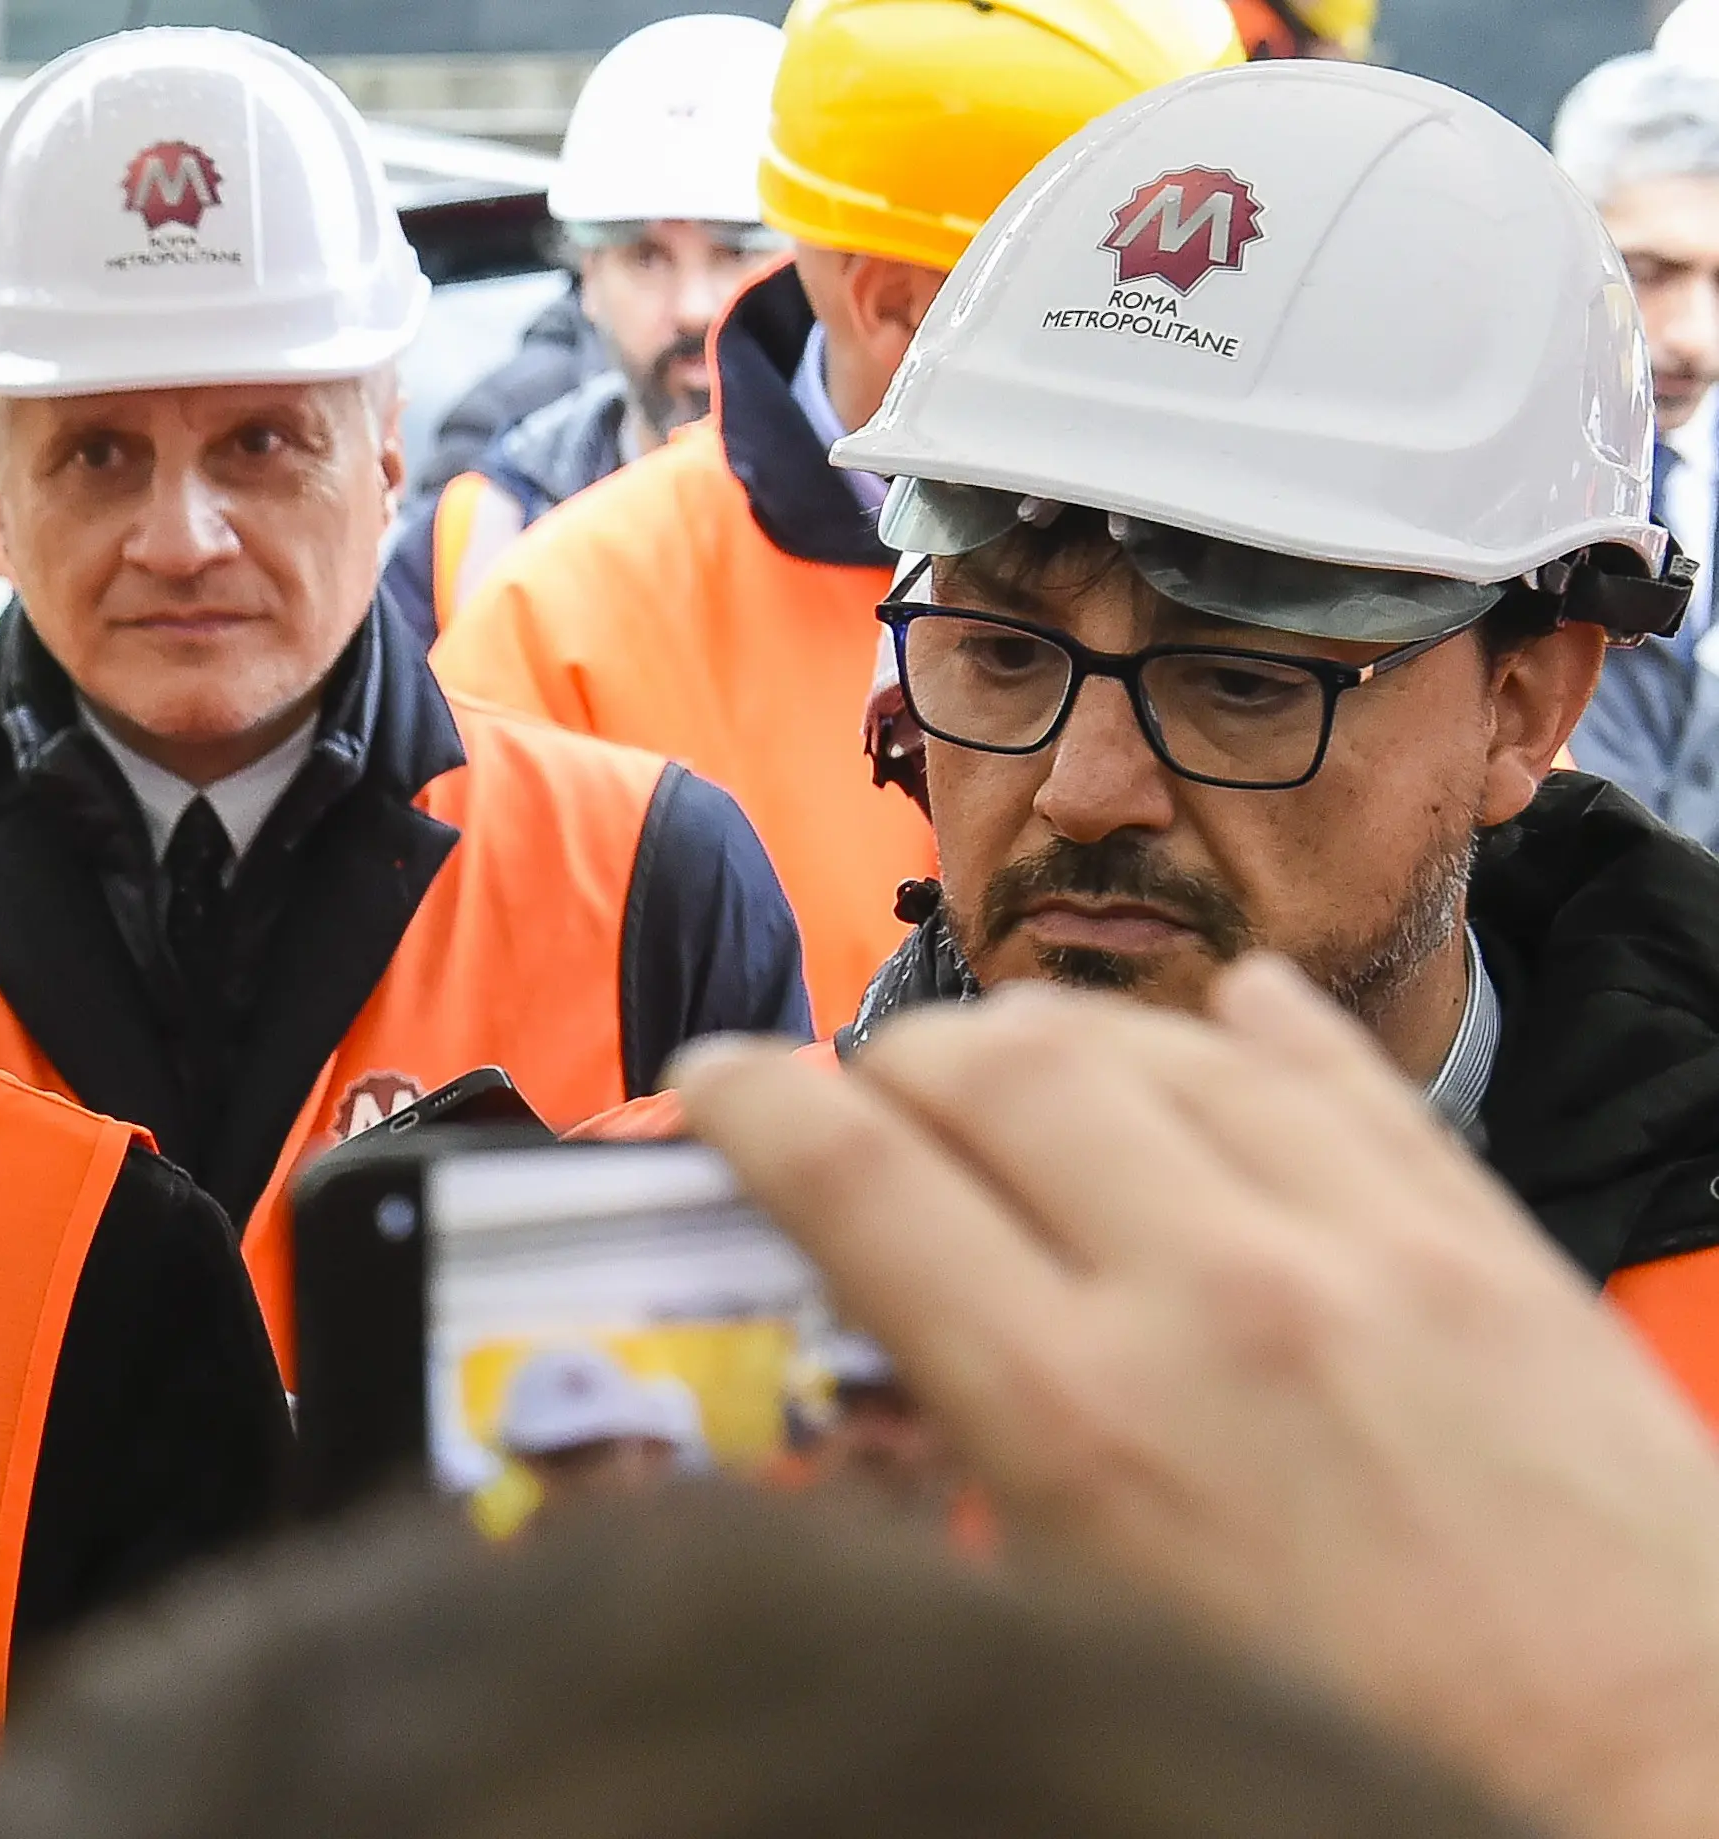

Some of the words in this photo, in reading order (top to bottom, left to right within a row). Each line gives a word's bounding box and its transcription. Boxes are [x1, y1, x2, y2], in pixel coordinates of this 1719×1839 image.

[1112, 183, 1235, 264] M
[1107, 288, 1179, 318] ROMA
[1041, 309, 1240, 358] METROPOLITANE
